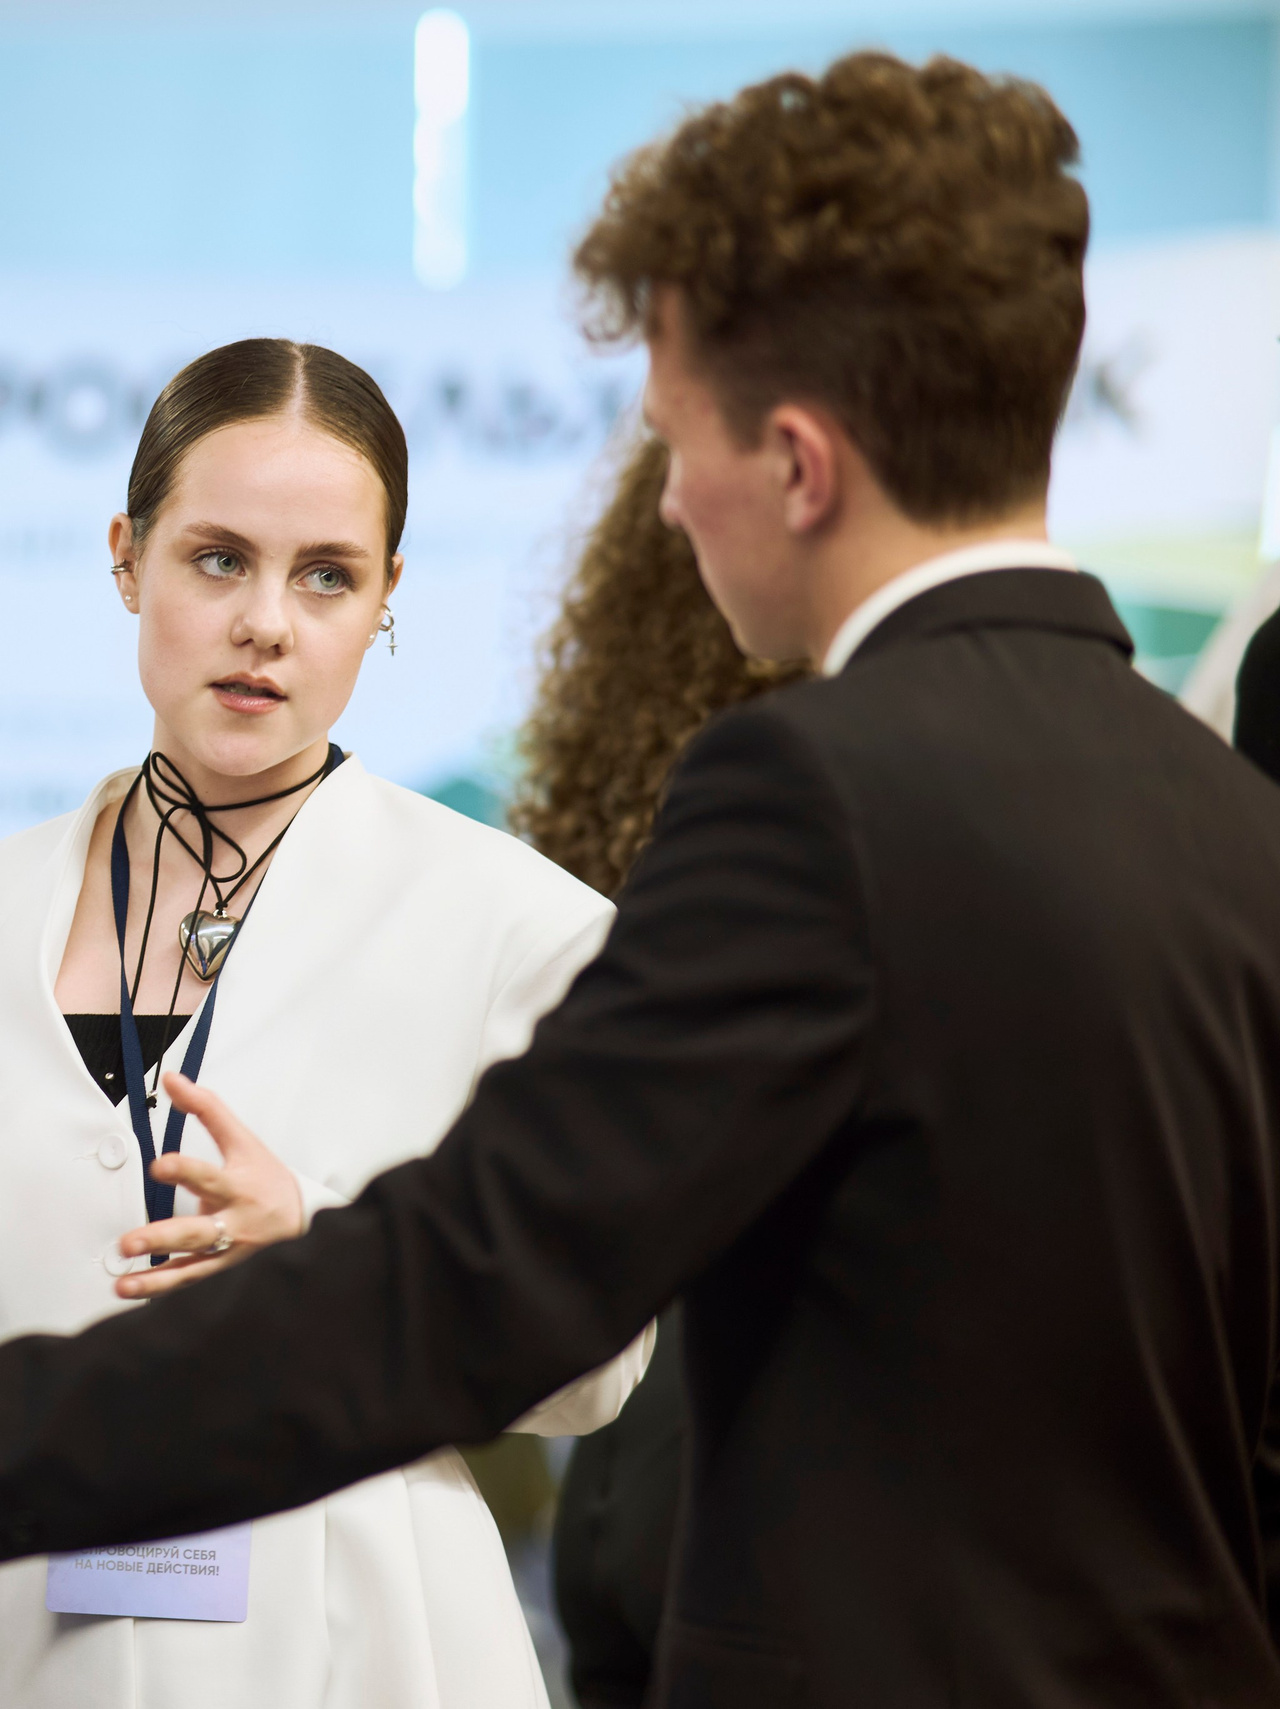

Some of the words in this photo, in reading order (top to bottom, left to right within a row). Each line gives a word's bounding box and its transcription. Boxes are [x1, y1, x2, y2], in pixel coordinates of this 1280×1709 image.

[183, 1548, 217, 1561] СЕБЯ
[74, 1558, 93, 1570] НА
[96, 1559, 144, 1573] НОВЫЕ
[146, 1561, 221, 1577] ДЕЙСТВИЯ!
